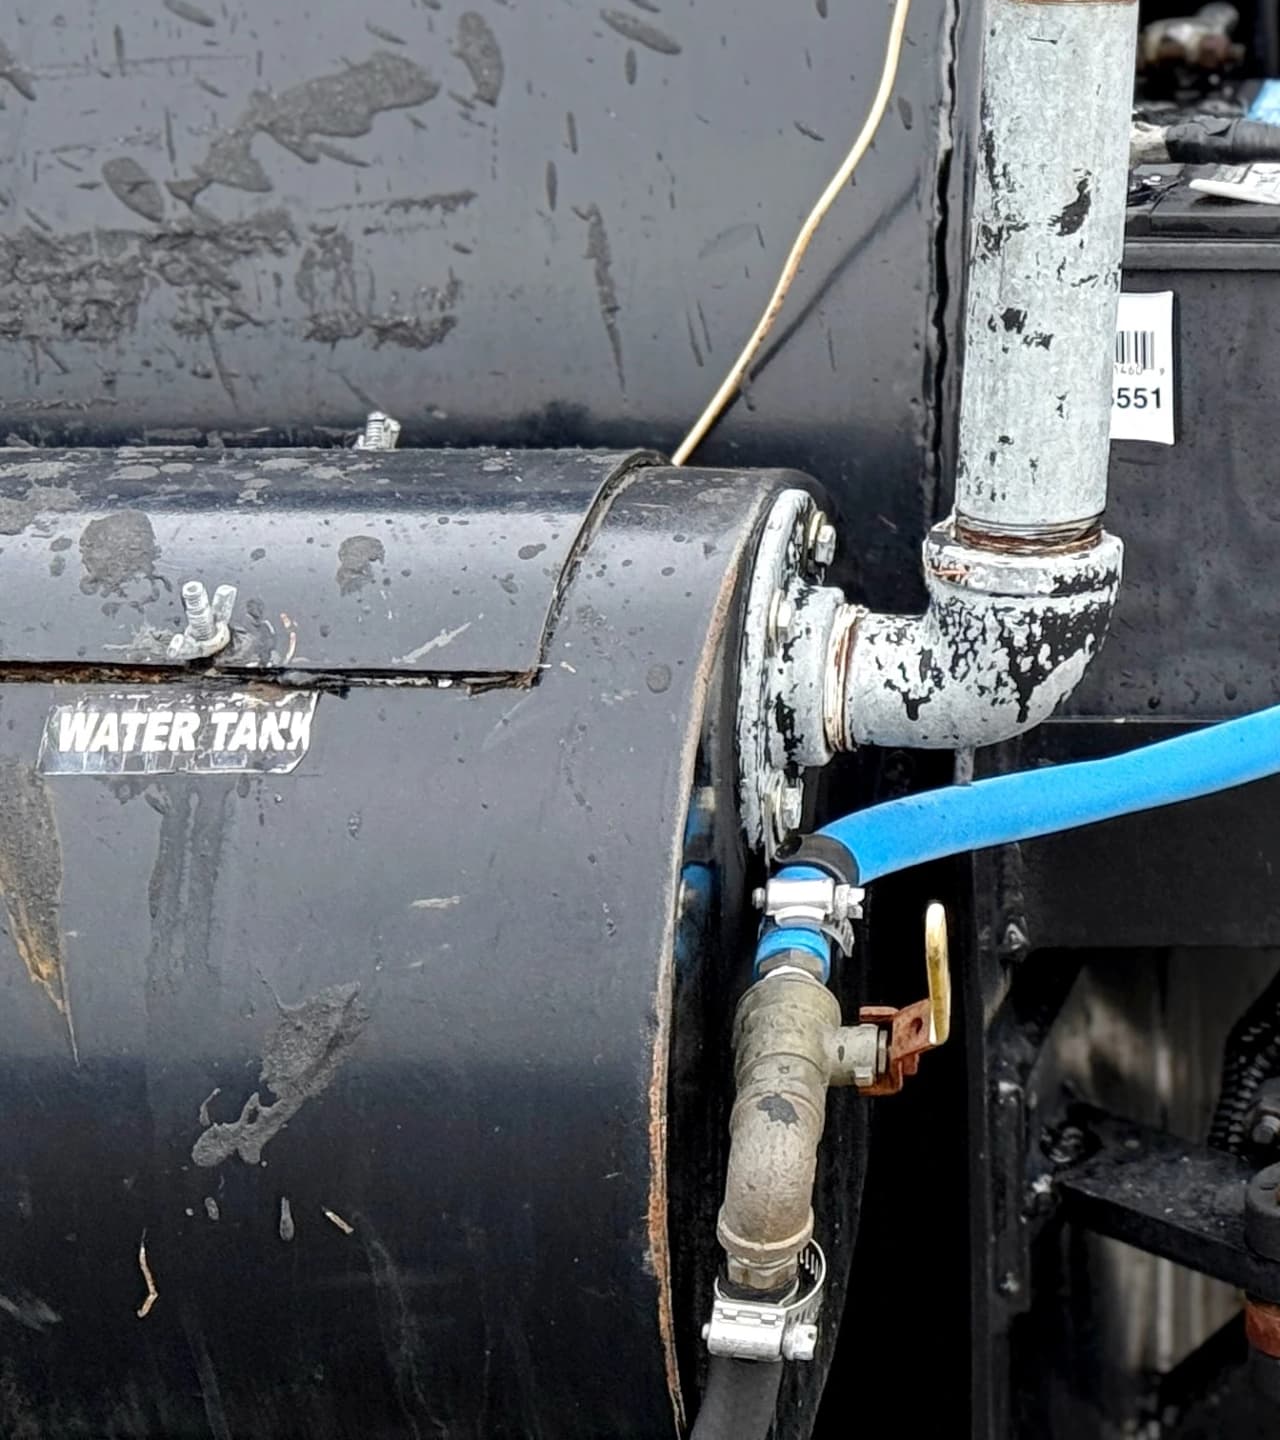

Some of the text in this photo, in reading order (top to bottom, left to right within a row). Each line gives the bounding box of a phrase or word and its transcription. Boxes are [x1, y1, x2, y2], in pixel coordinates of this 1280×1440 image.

[1111, 386, 1162, 410] 551
[58, 710, 313, 753] WATER TANK
